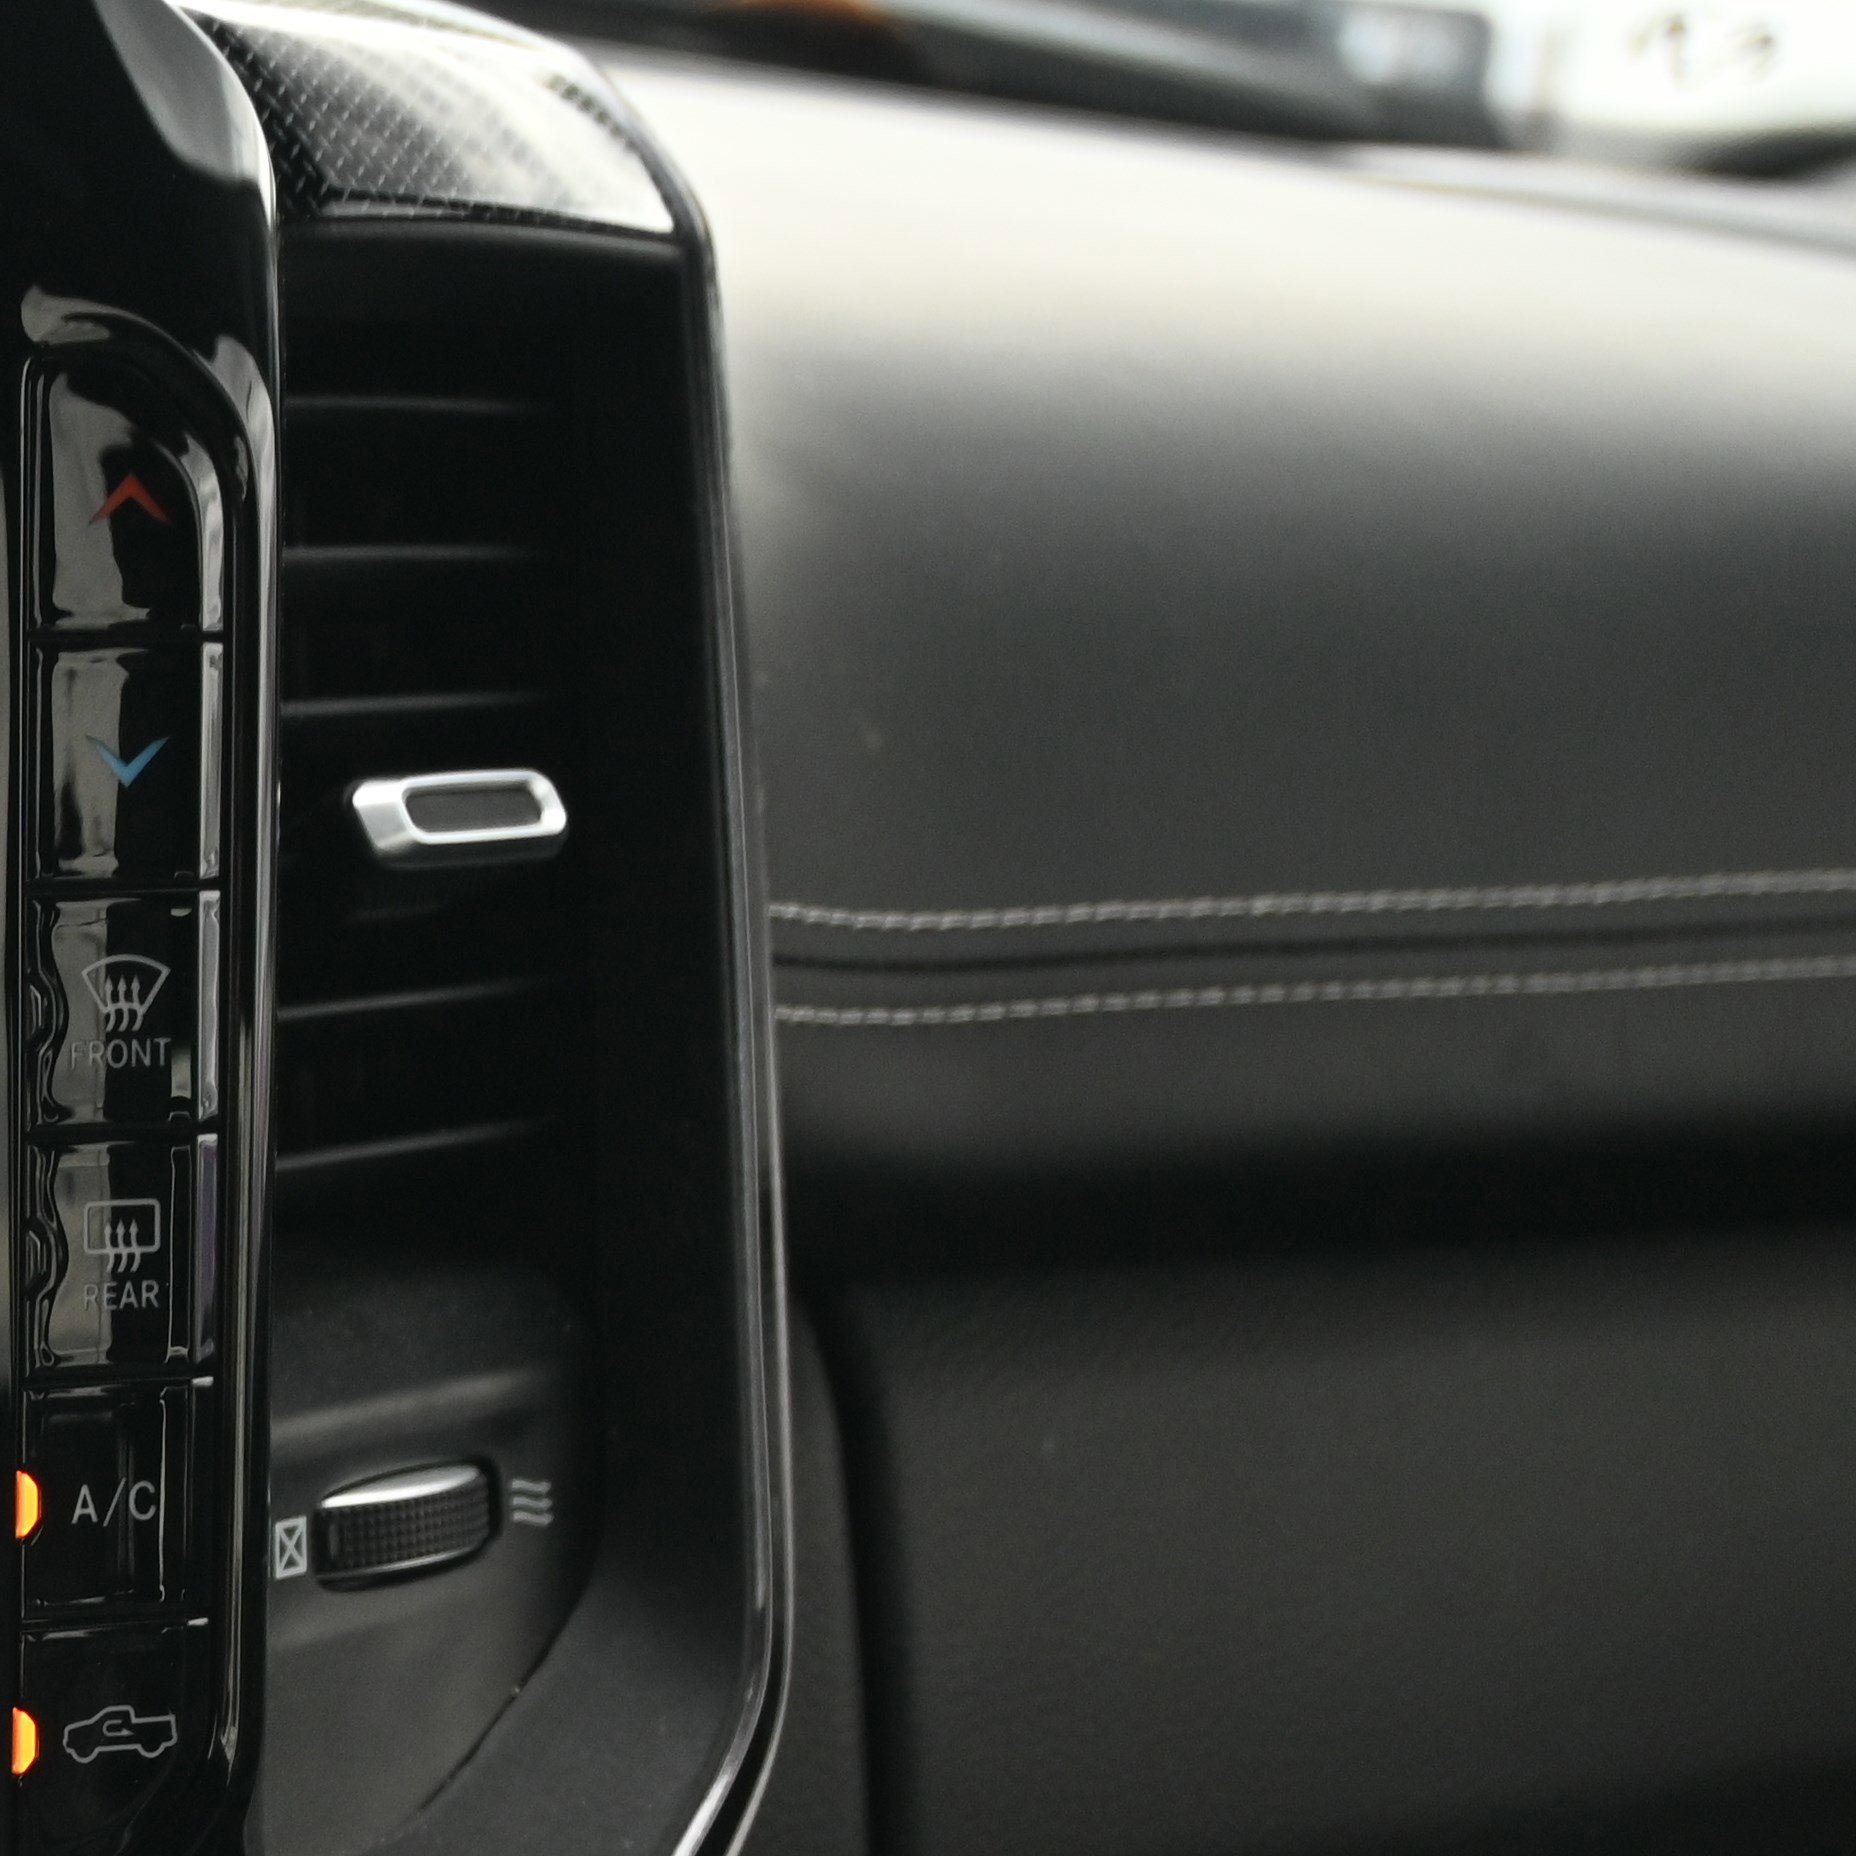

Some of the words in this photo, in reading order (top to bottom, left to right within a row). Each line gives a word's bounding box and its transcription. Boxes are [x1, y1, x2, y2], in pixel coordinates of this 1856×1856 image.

[69, 1036, 172, 1070] FRONT
[82, 1279, 160, 1311] REAR
[71, 1477, 156, 1528] A/C
